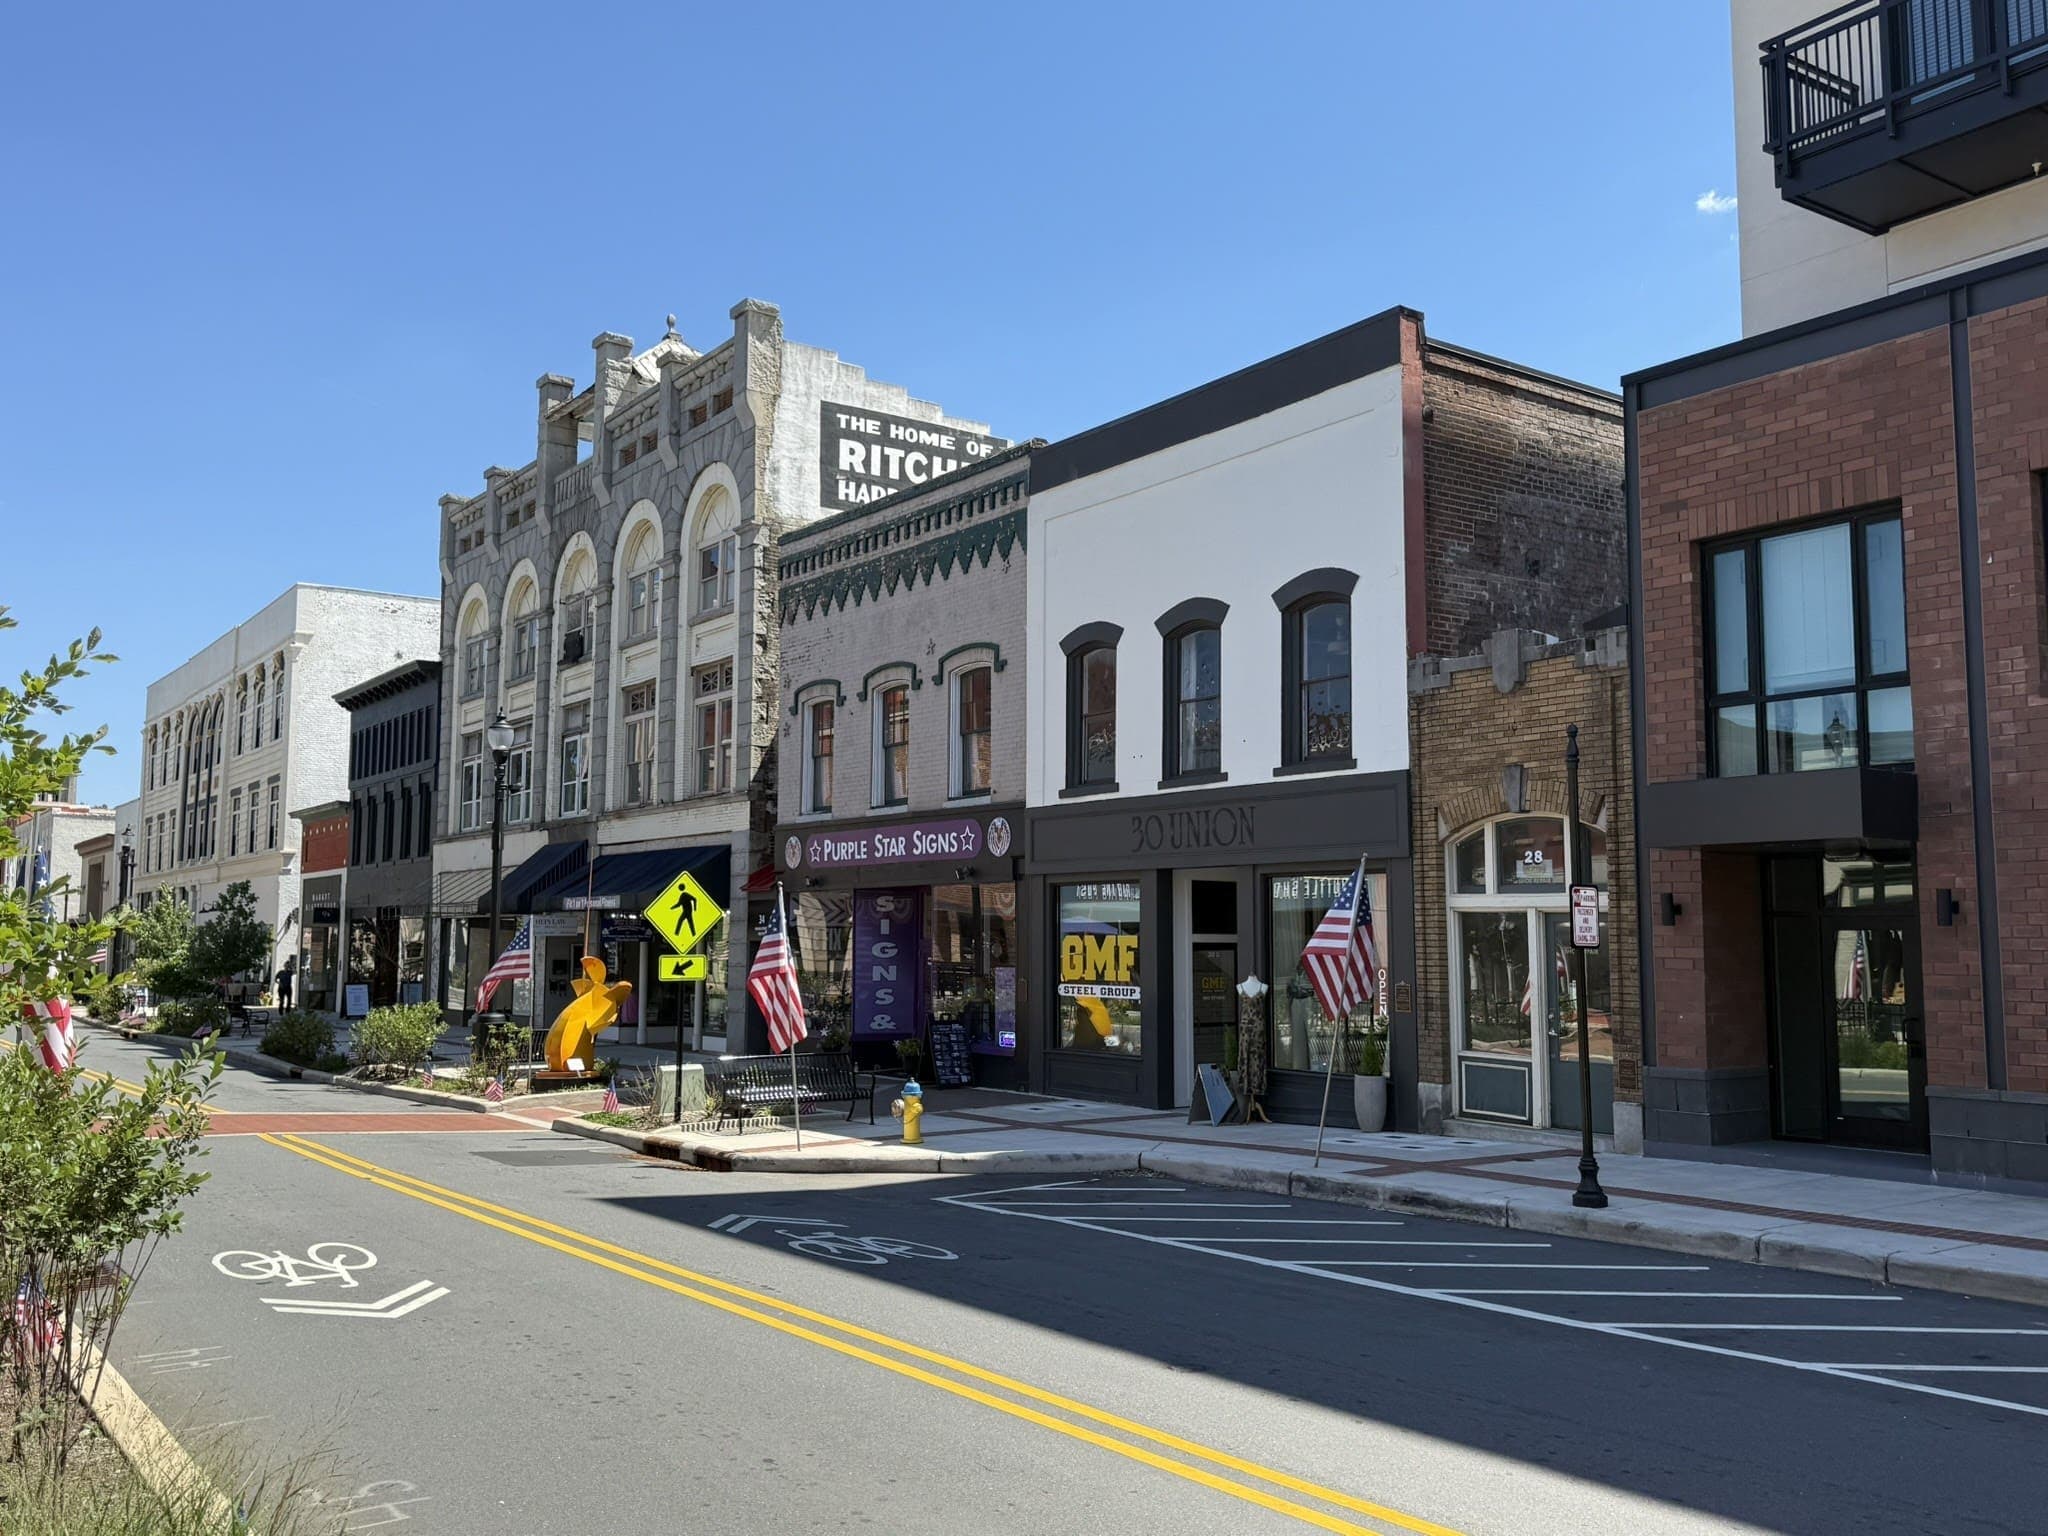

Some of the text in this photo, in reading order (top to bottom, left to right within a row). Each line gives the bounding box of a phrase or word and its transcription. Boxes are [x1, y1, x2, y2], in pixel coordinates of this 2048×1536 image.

[836, 413, 993, 458] THE HOME OF
[823, 829, 958, 862] PURPLE STAR SIGNS
[1131, 806, 1257, 853] 30 UNION
[1524, 850, 1543, 864] 28
[1062, 935, 1138, 982] GMF
[1063, 985, 1137, 998] STEEL GROUP
[1378, 968, 1388, 1016] OPEN
